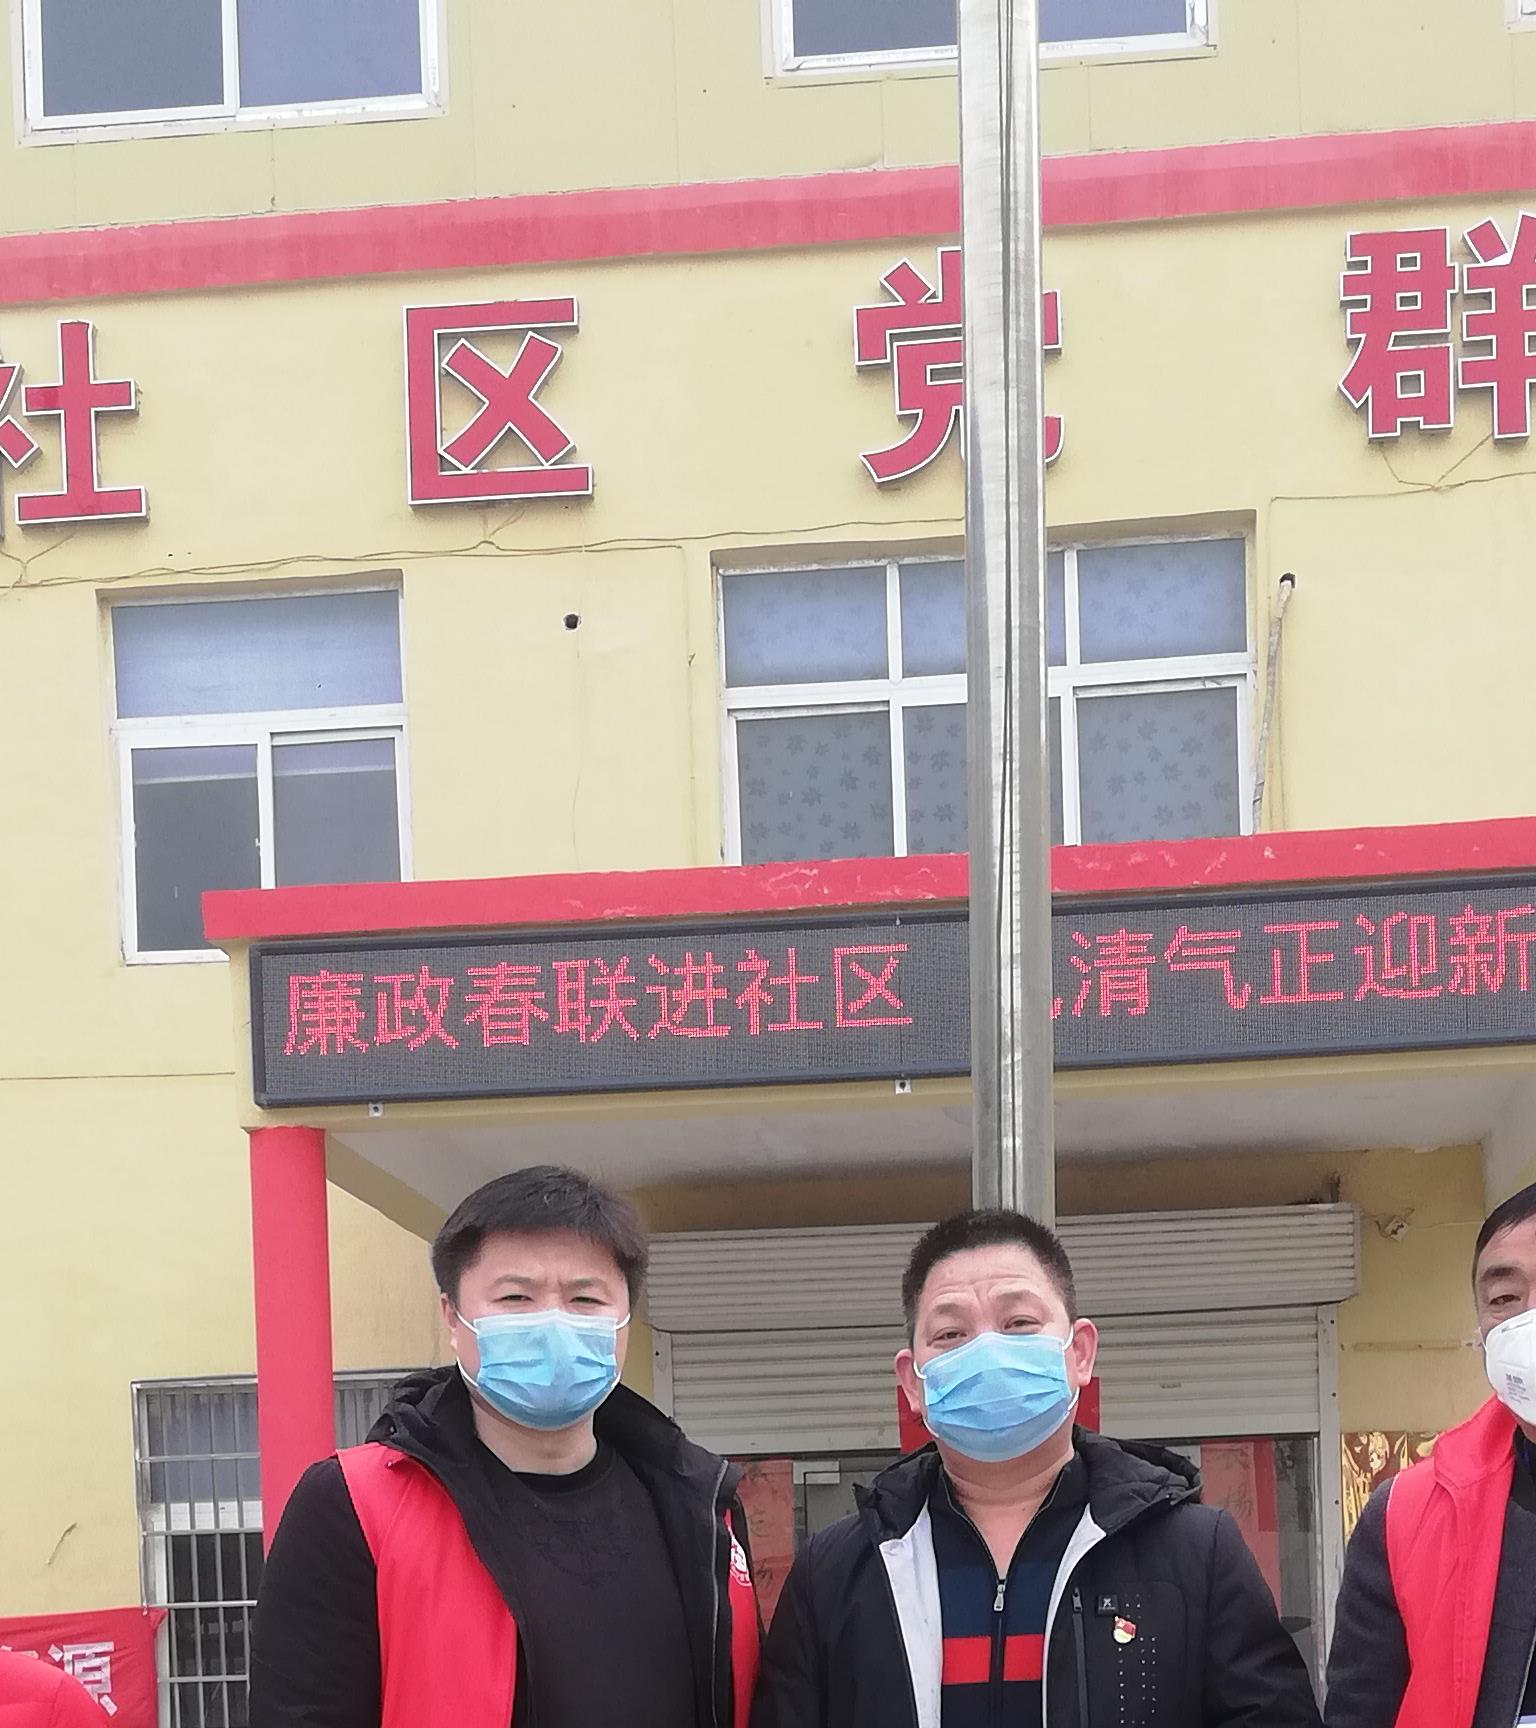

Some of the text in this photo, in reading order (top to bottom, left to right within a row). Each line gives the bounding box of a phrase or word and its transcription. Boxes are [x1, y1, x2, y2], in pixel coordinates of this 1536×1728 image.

[283, 944, 913, 1056] 廉政春联进社区
